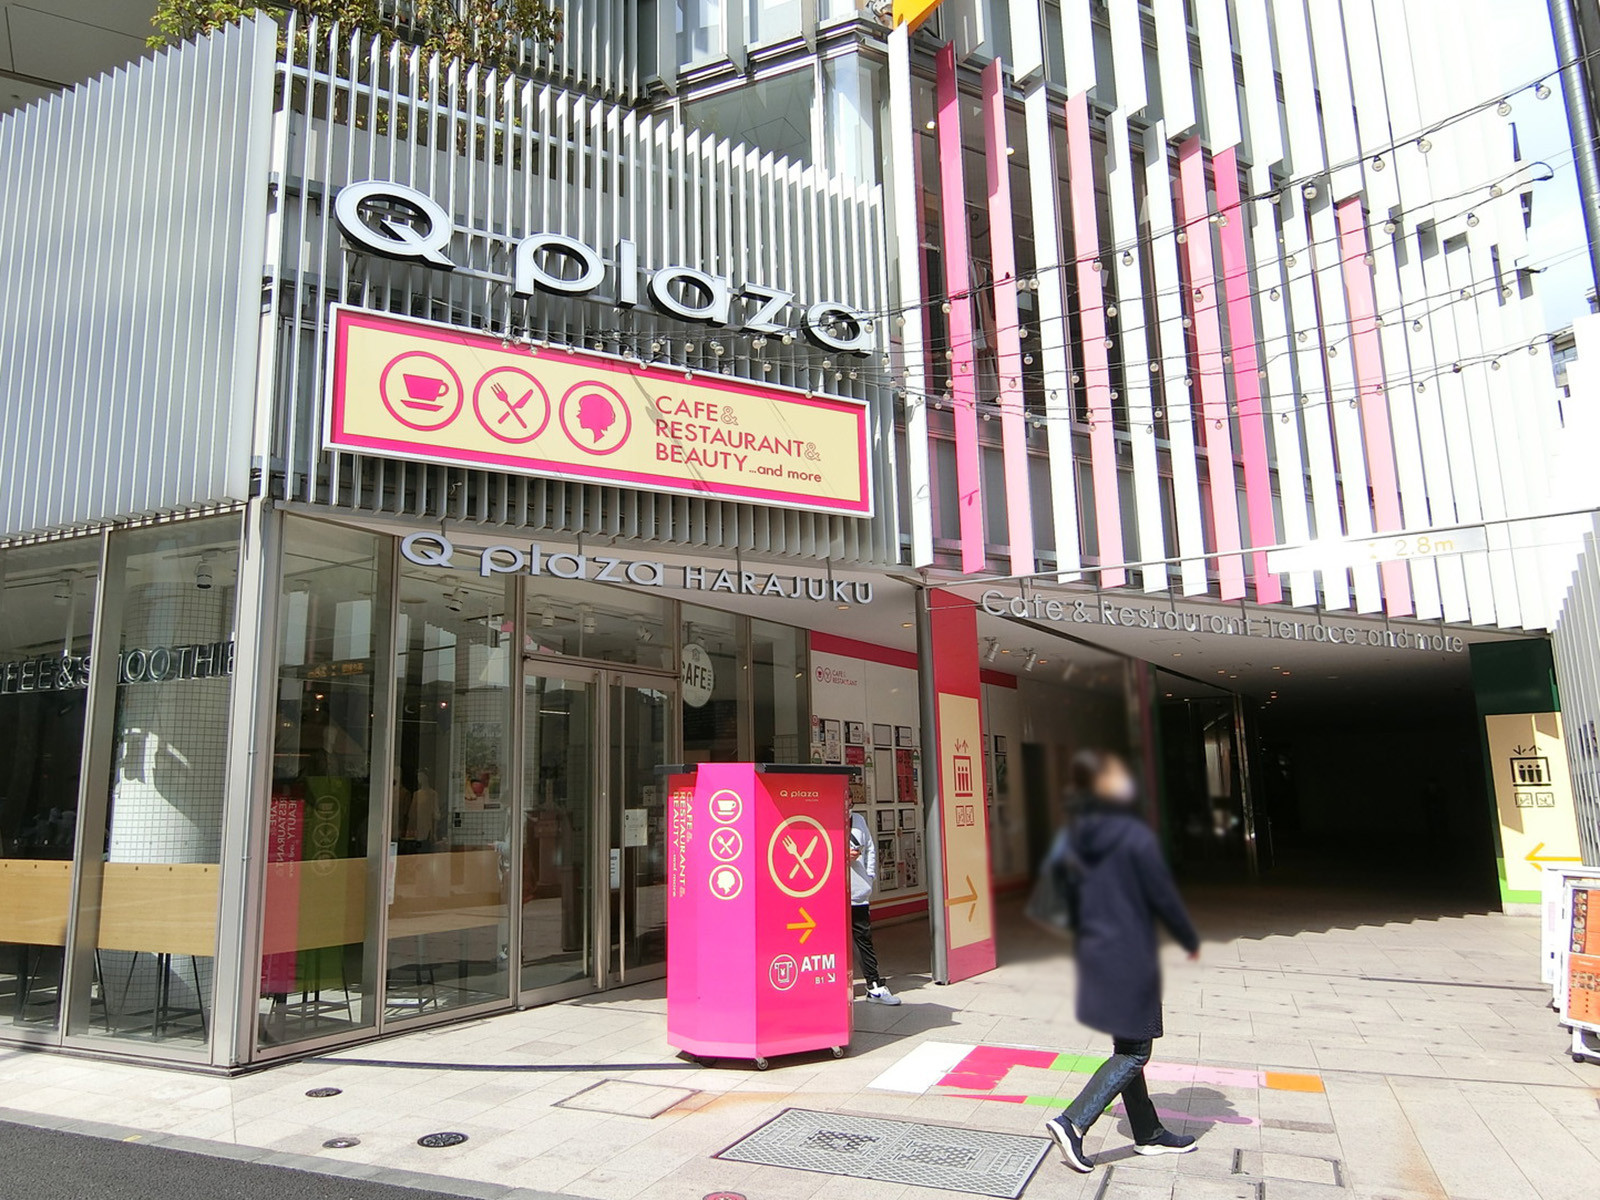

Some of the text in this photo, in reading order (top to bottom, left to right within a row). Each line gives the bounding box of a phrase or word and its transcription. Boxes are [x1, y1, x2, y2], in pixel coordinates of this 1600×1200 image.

[334, 180, 874, 357] Q plaza
[656, 442, 748, 472] BEAUTY
[787, 468, 822, 483] more
[400, 531, 874, 604] Q plaza HARAJUKU
[982, 589, 1064, 621] Cafe
[1071, 599, 1092, 623] &
[1101, 600, 1252, 636] Restaurant
[1368, 628, 1408, 648] and
[1415, 633, 1464, 653] more
[780, 789, 819, 798] Q plaza
[800, 953, 836, 973] ATM
